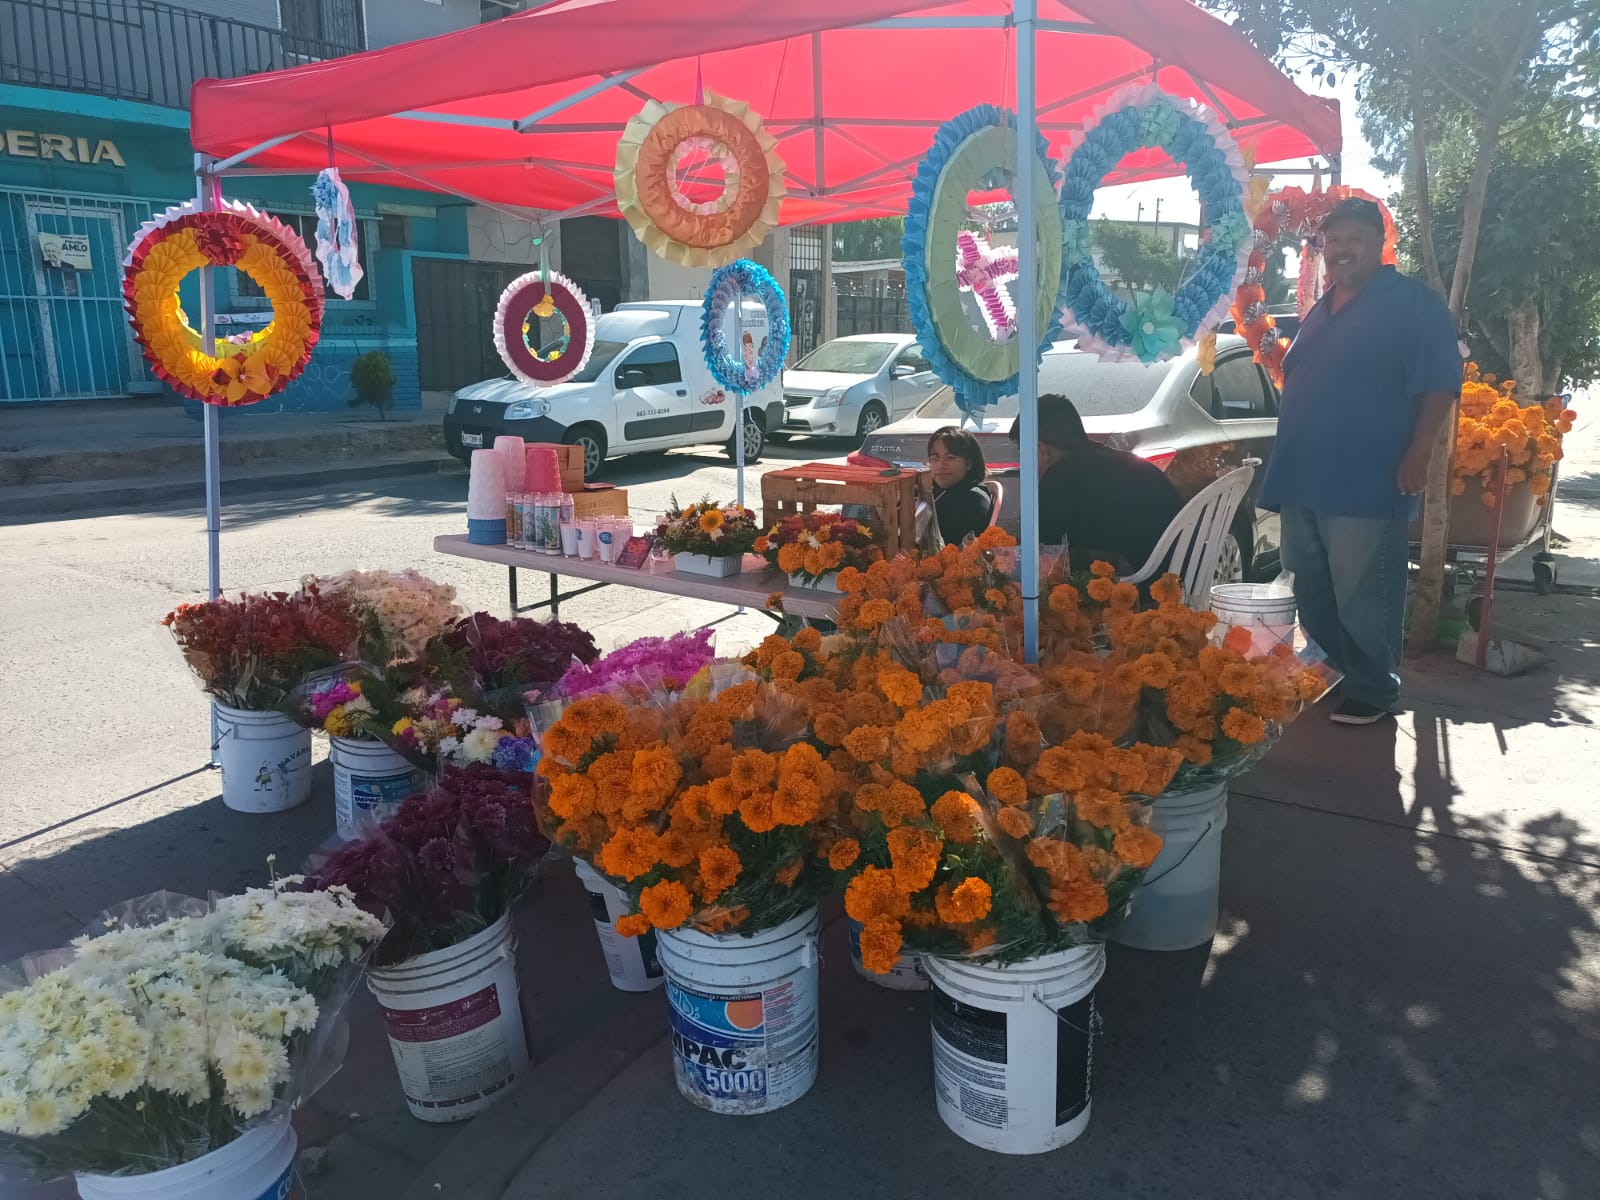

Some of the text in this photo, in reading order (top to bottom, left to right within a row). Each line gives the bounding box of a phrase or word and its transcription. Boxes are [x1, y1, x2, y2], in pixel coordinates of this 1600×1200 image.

[0, 129, 126, 167] ERIA
[62, 243, 88, 252] AMLO
[705, 1069, 764, 1093] 5000
